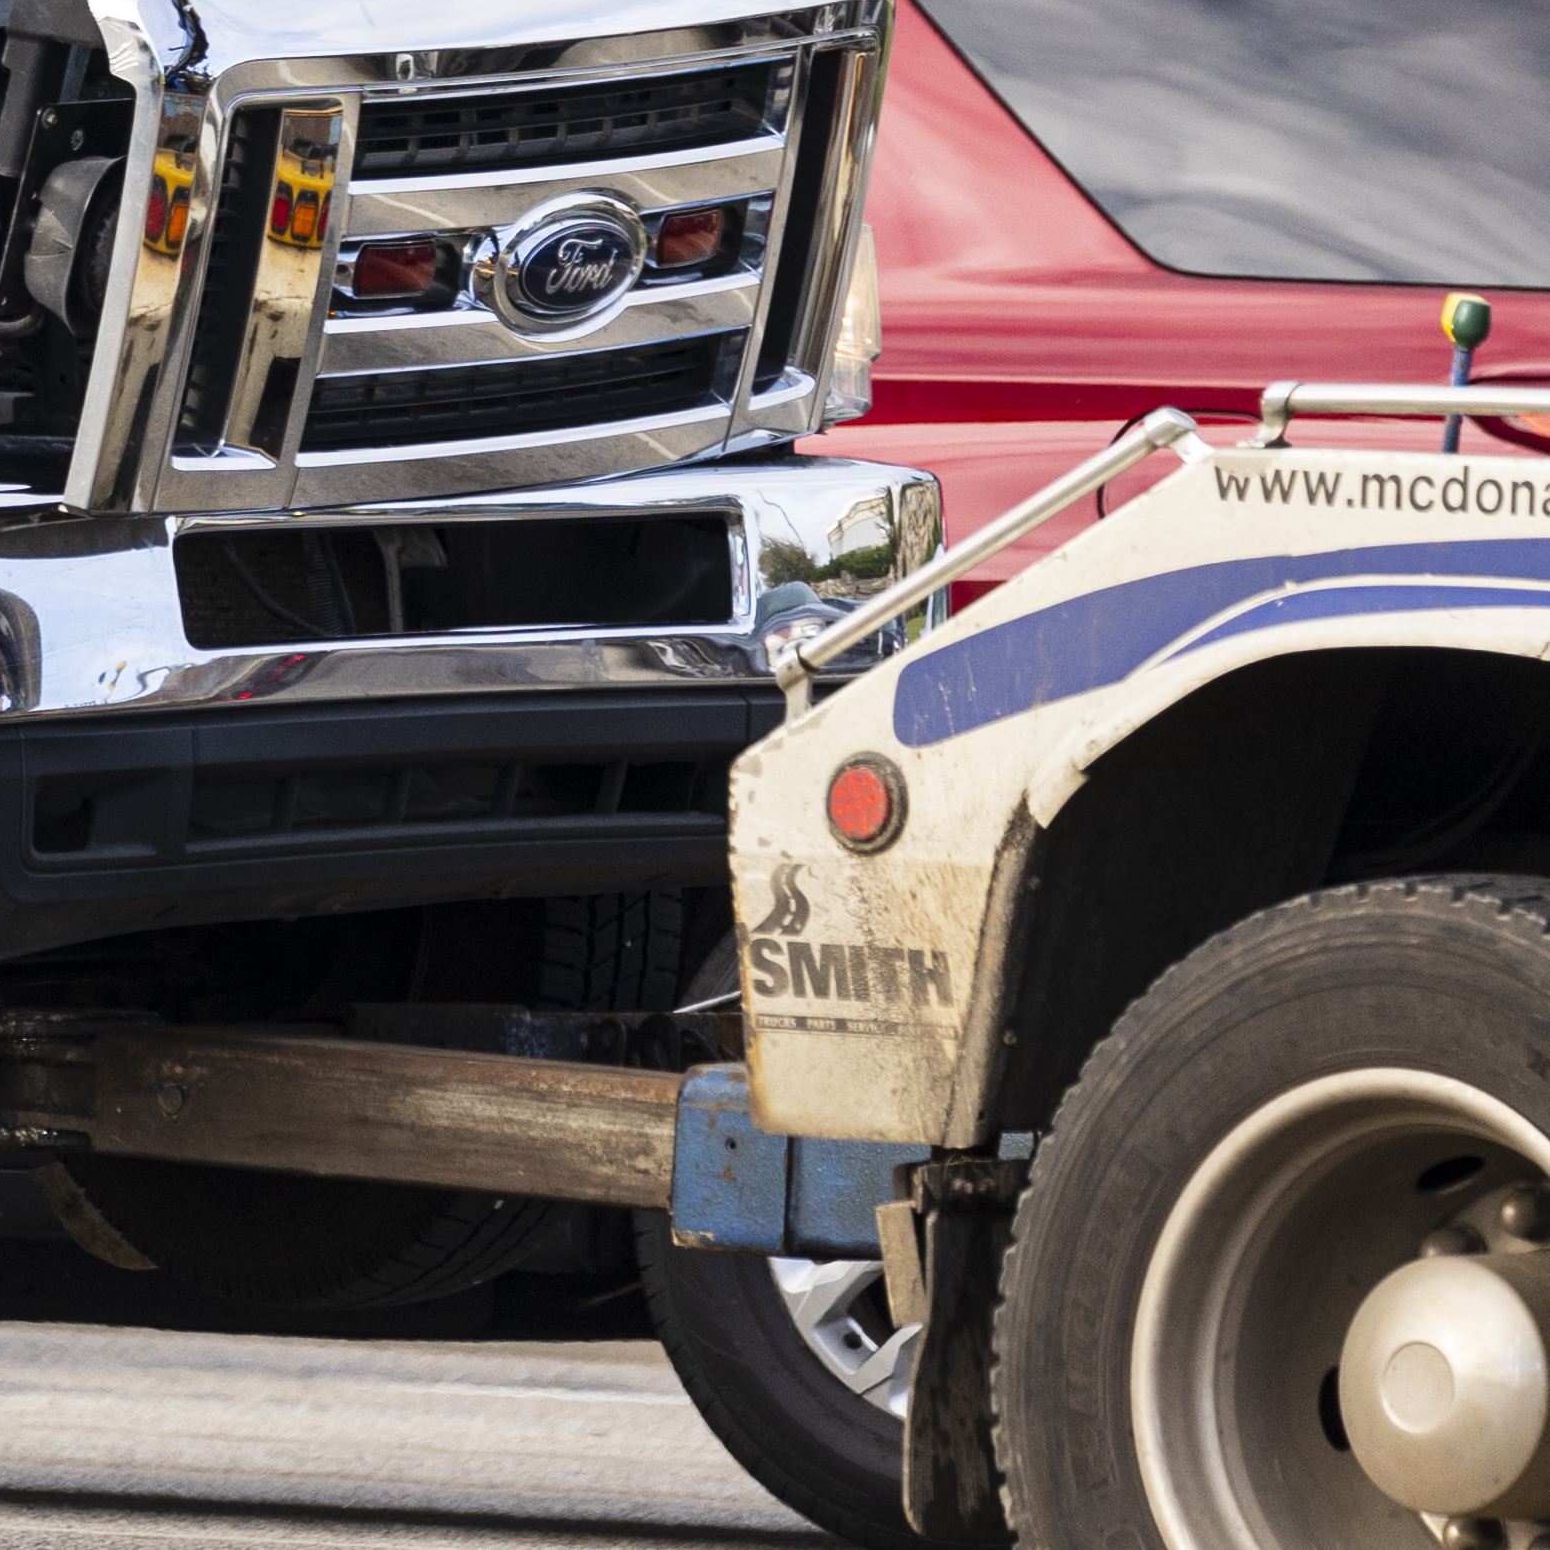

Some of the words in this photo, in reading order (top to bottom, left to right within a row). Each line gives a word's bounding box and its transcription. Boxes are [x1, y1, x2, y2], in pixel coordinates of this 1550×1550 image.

[545, 238, 618, 294] Ford
[750, 938, 955, 1007] SMITH
[757, 1016, 797, 1028] TRUCKS
[806, 1019, 837, 1031] PARTS
